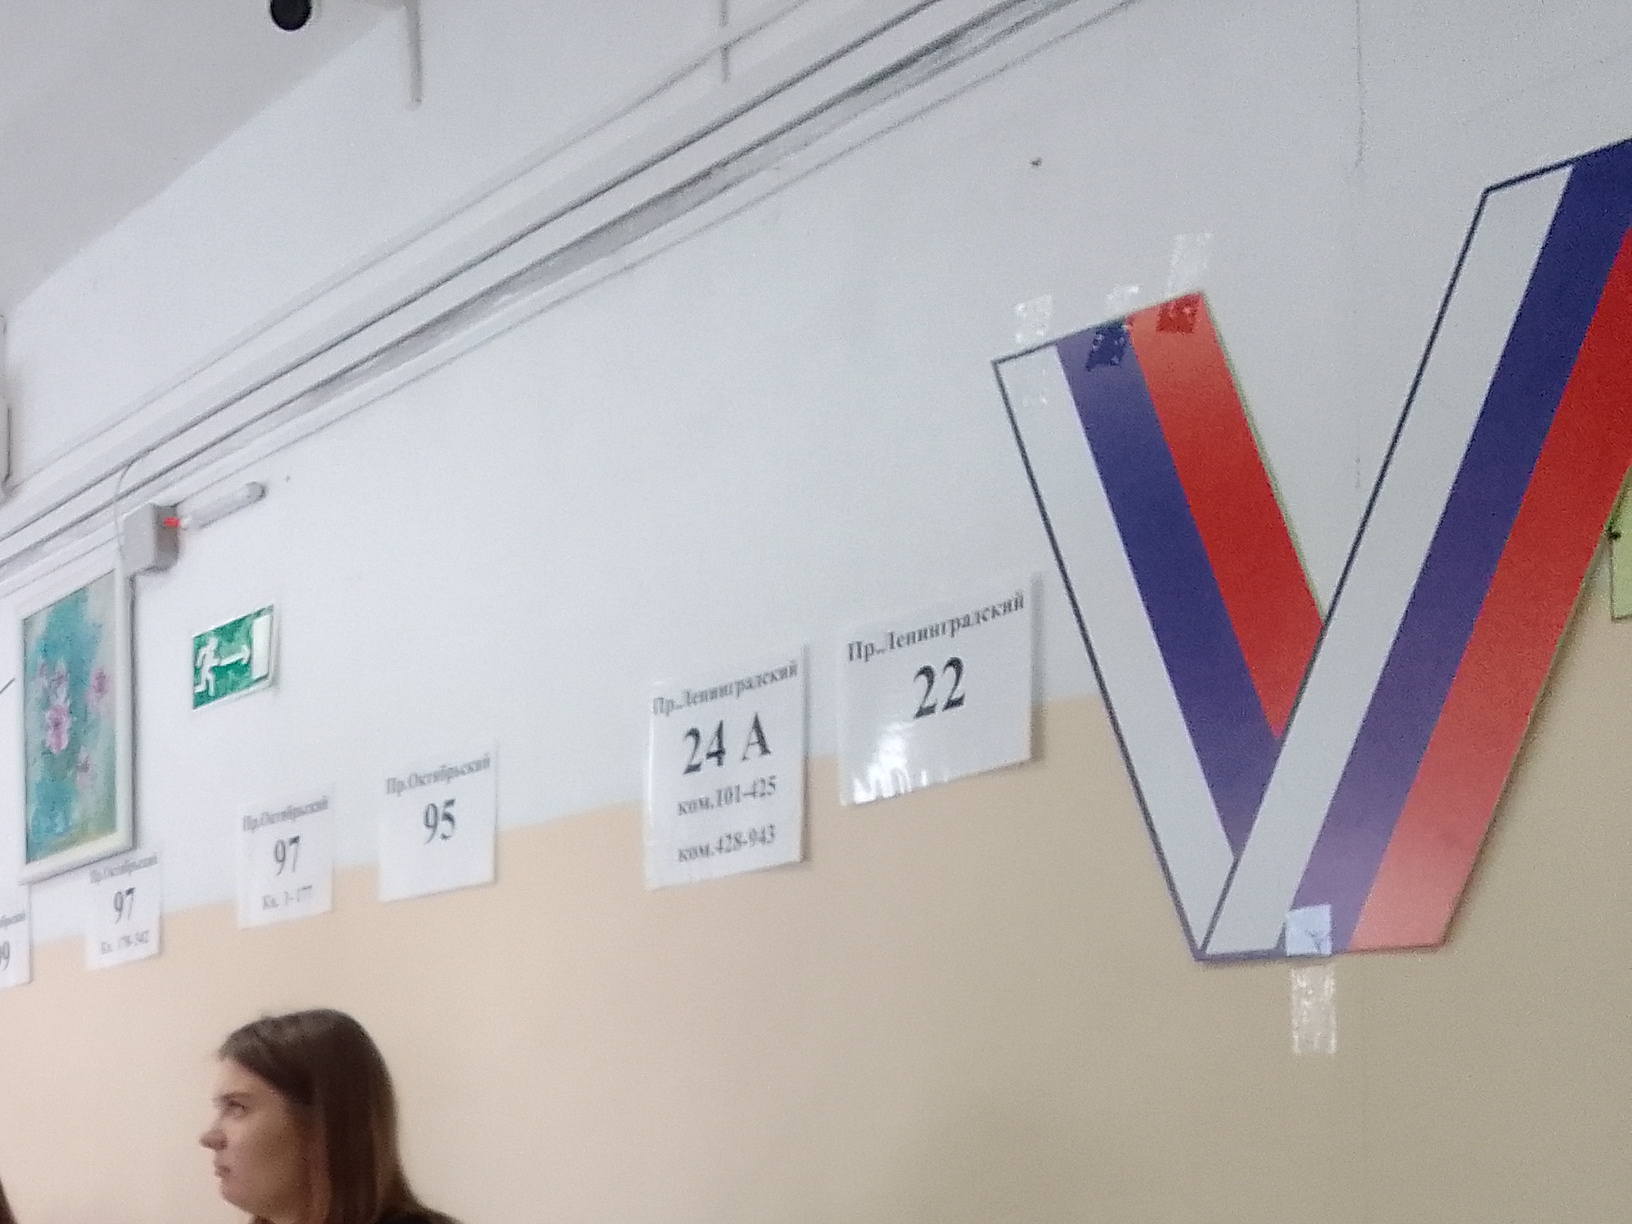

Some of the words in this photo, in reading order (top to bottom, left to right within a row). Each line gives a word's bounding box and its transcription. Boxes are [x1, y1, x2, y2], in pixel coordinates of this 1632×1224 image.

[913, 656, 966, 719] 22
[683, 719, 727, 775] 24
[741, 712, 772, 761] А
[424, 799, 456, 845] 95
[274, 835, 301, 876] 97
[113, 887, 136, 925] 97
